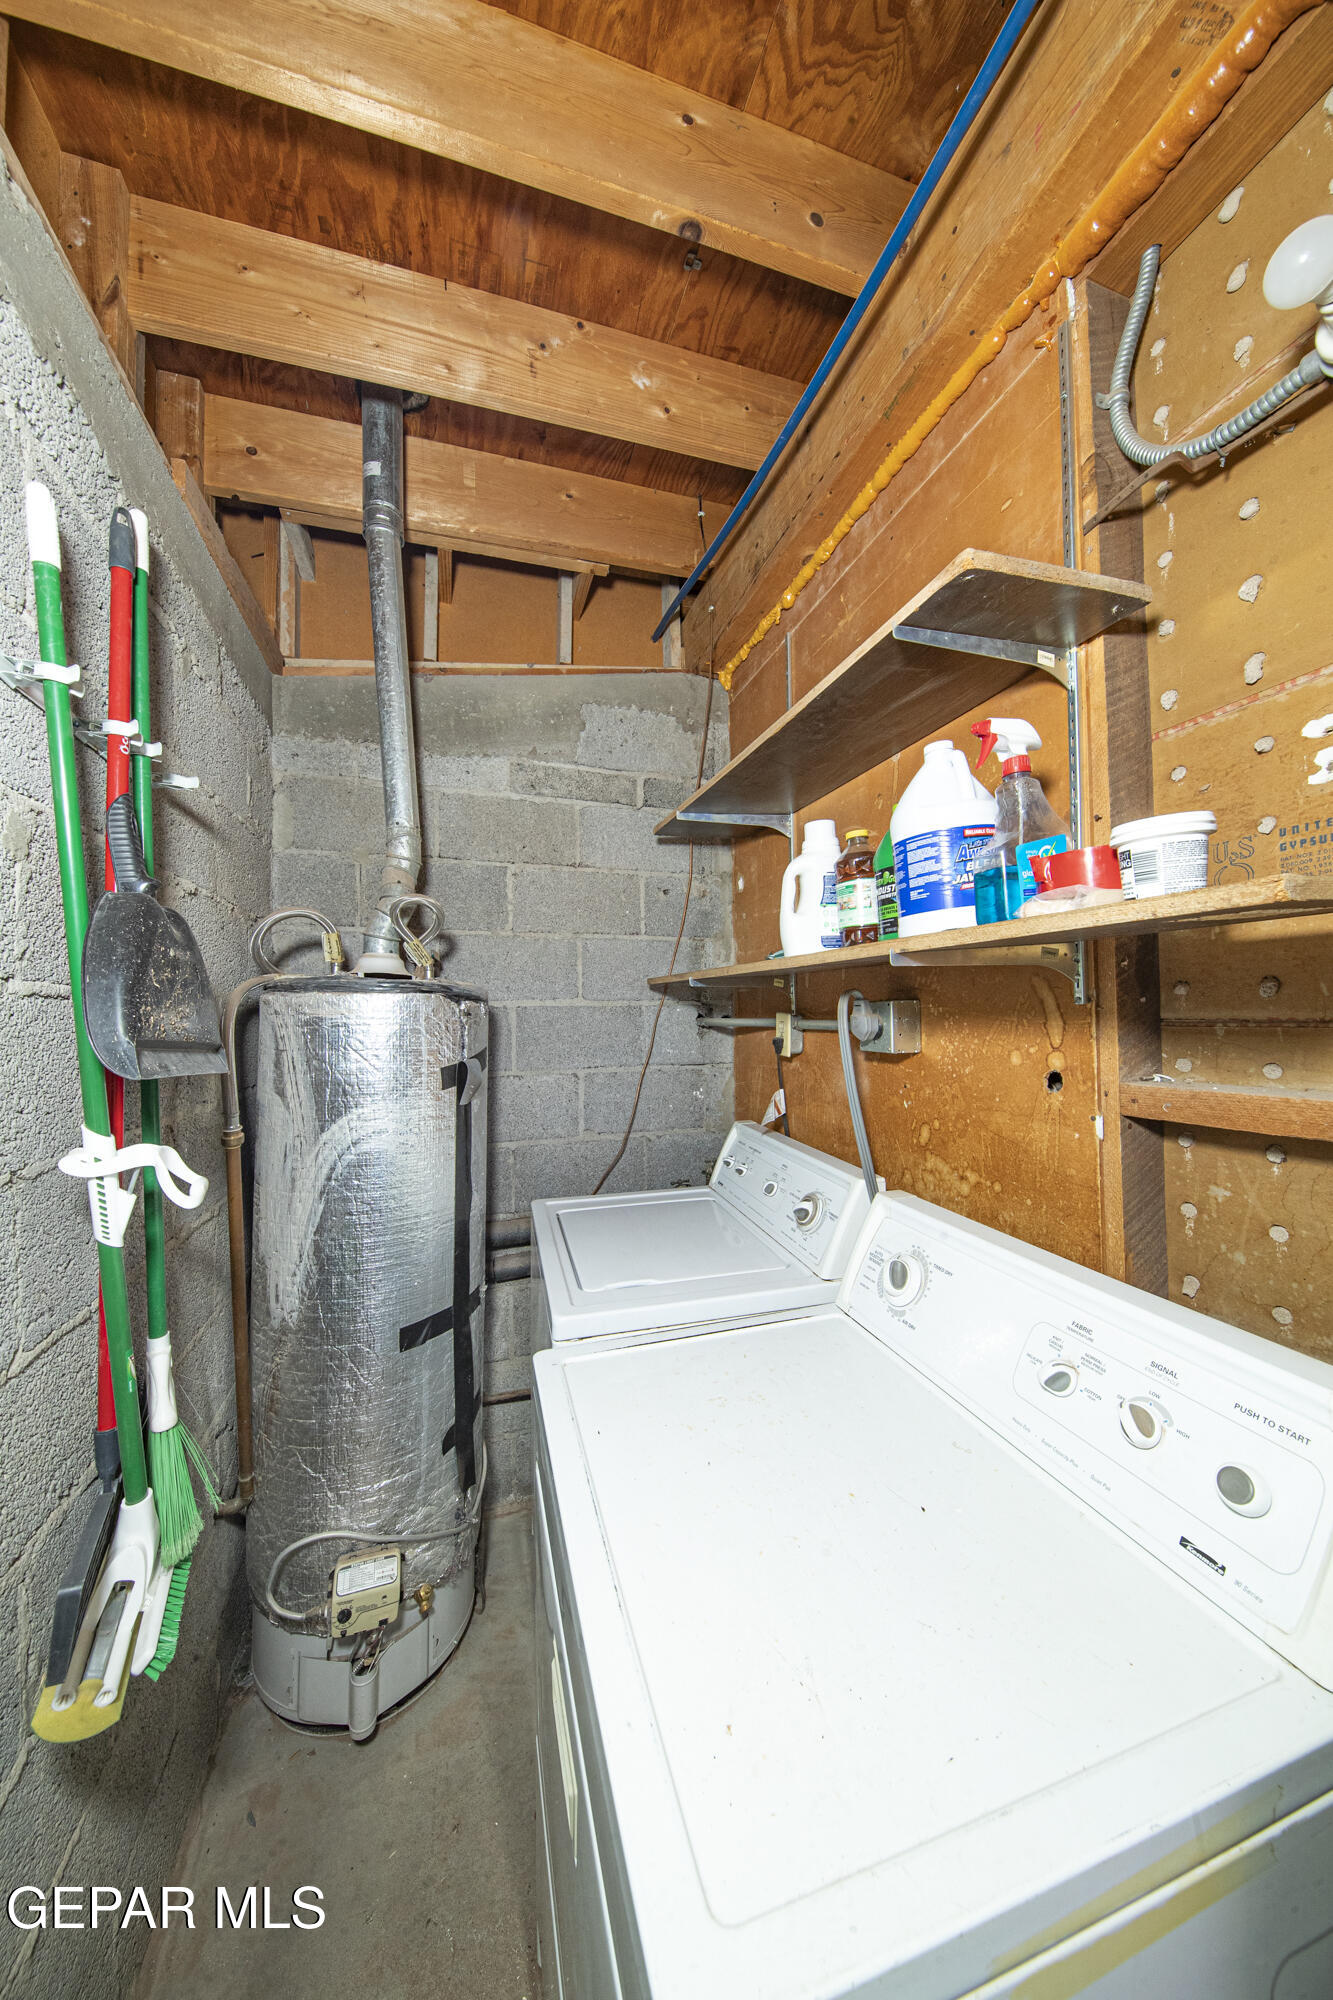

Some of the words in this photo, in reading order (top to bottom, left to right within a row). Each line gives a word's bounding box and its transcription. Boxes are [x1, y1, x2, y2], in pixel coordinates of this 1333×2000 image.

[1022, 870, 1034, 878] gla
[1071, 1321, 1094, 1336] FABRIC
[1150, 1361, 1179, 1380] SIGNAL
[1084, 1387, 1102, 1400] COTTON
[1148, 1390, 1162, 1400] LOW
[1233, 1402, 1261, 1421] PUSH
[1262, 1415, 1276, 1429] TO
[1278, 1423, 1312, 1447] START
[1176, 1428, 1191, 1440] HIGH
[1185, 1544, 1225, 1576] Kenmore
